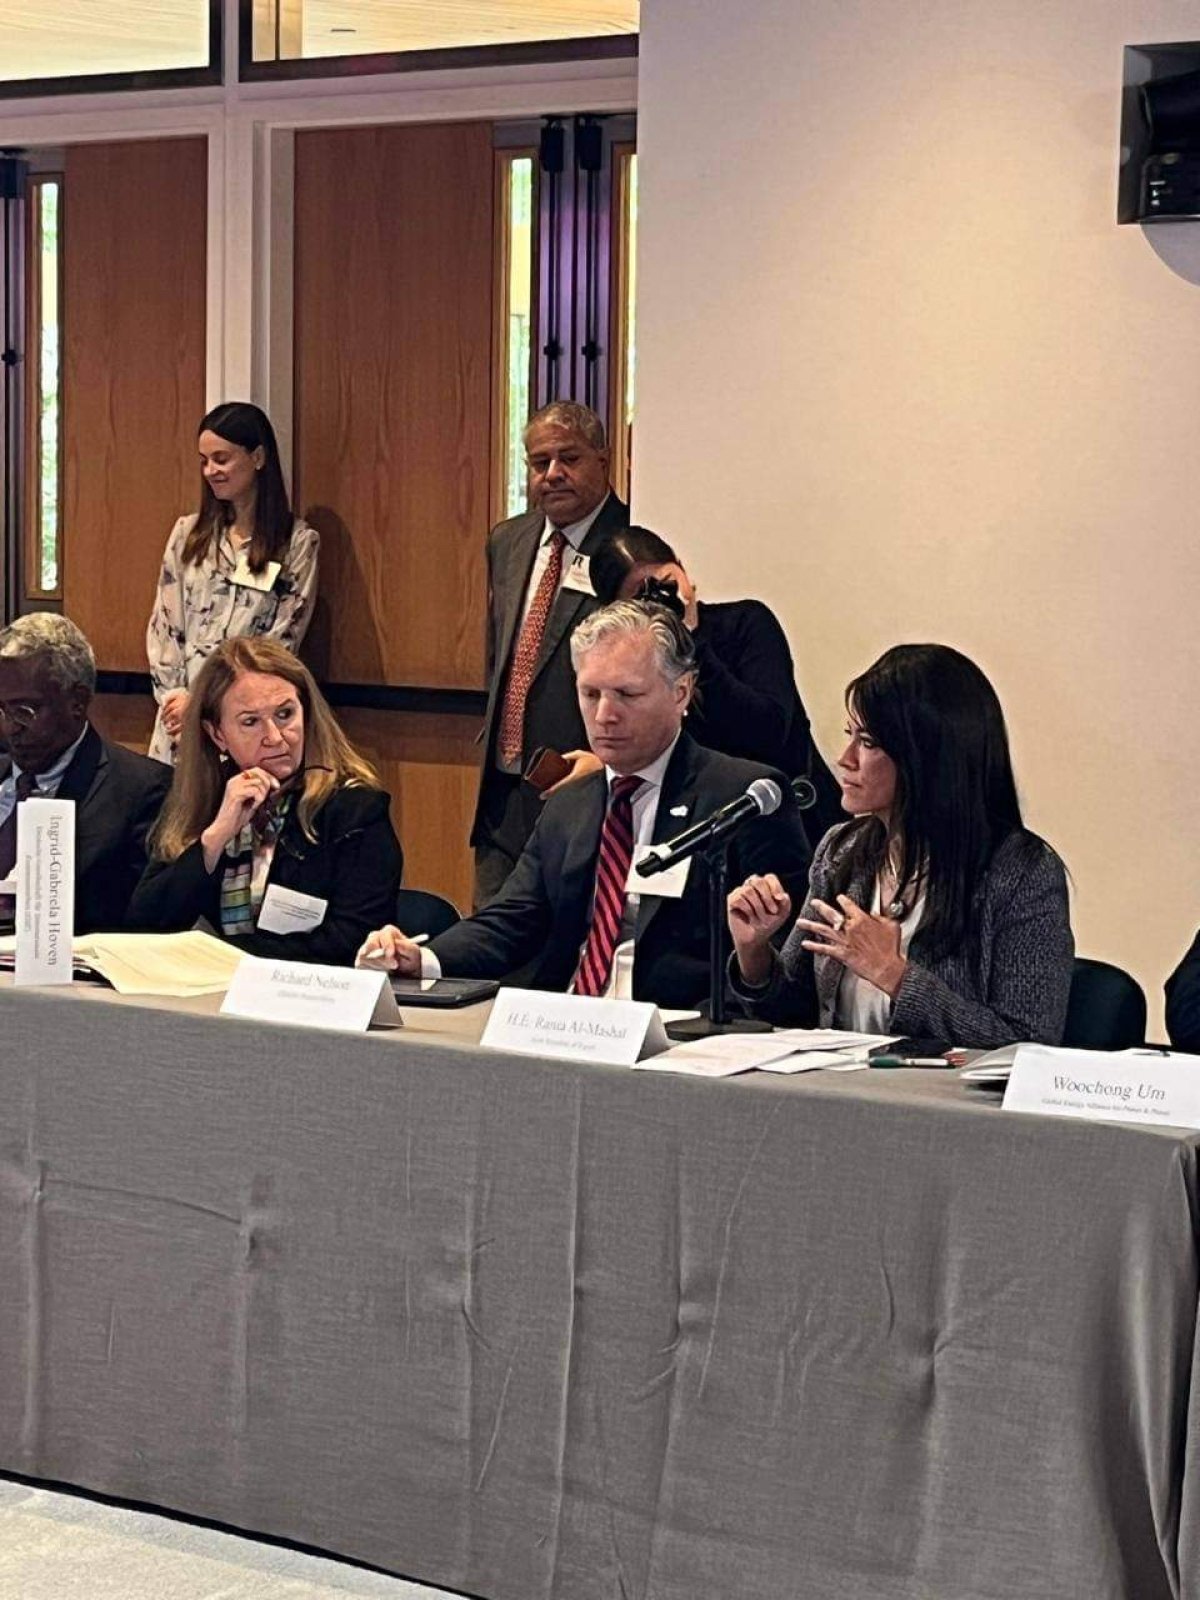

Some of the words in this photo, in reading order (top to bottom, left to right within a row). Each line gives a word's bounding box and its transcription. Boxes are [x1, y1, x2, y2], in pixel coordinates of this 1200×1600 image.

[46, 815, 63, 918] Ingrid-Gabriela
[48, 922, 61, 966] Hoven
[1053, 1075, 1133, 1101] Woochong
[1138, 1083, 1166, 1101] Um
